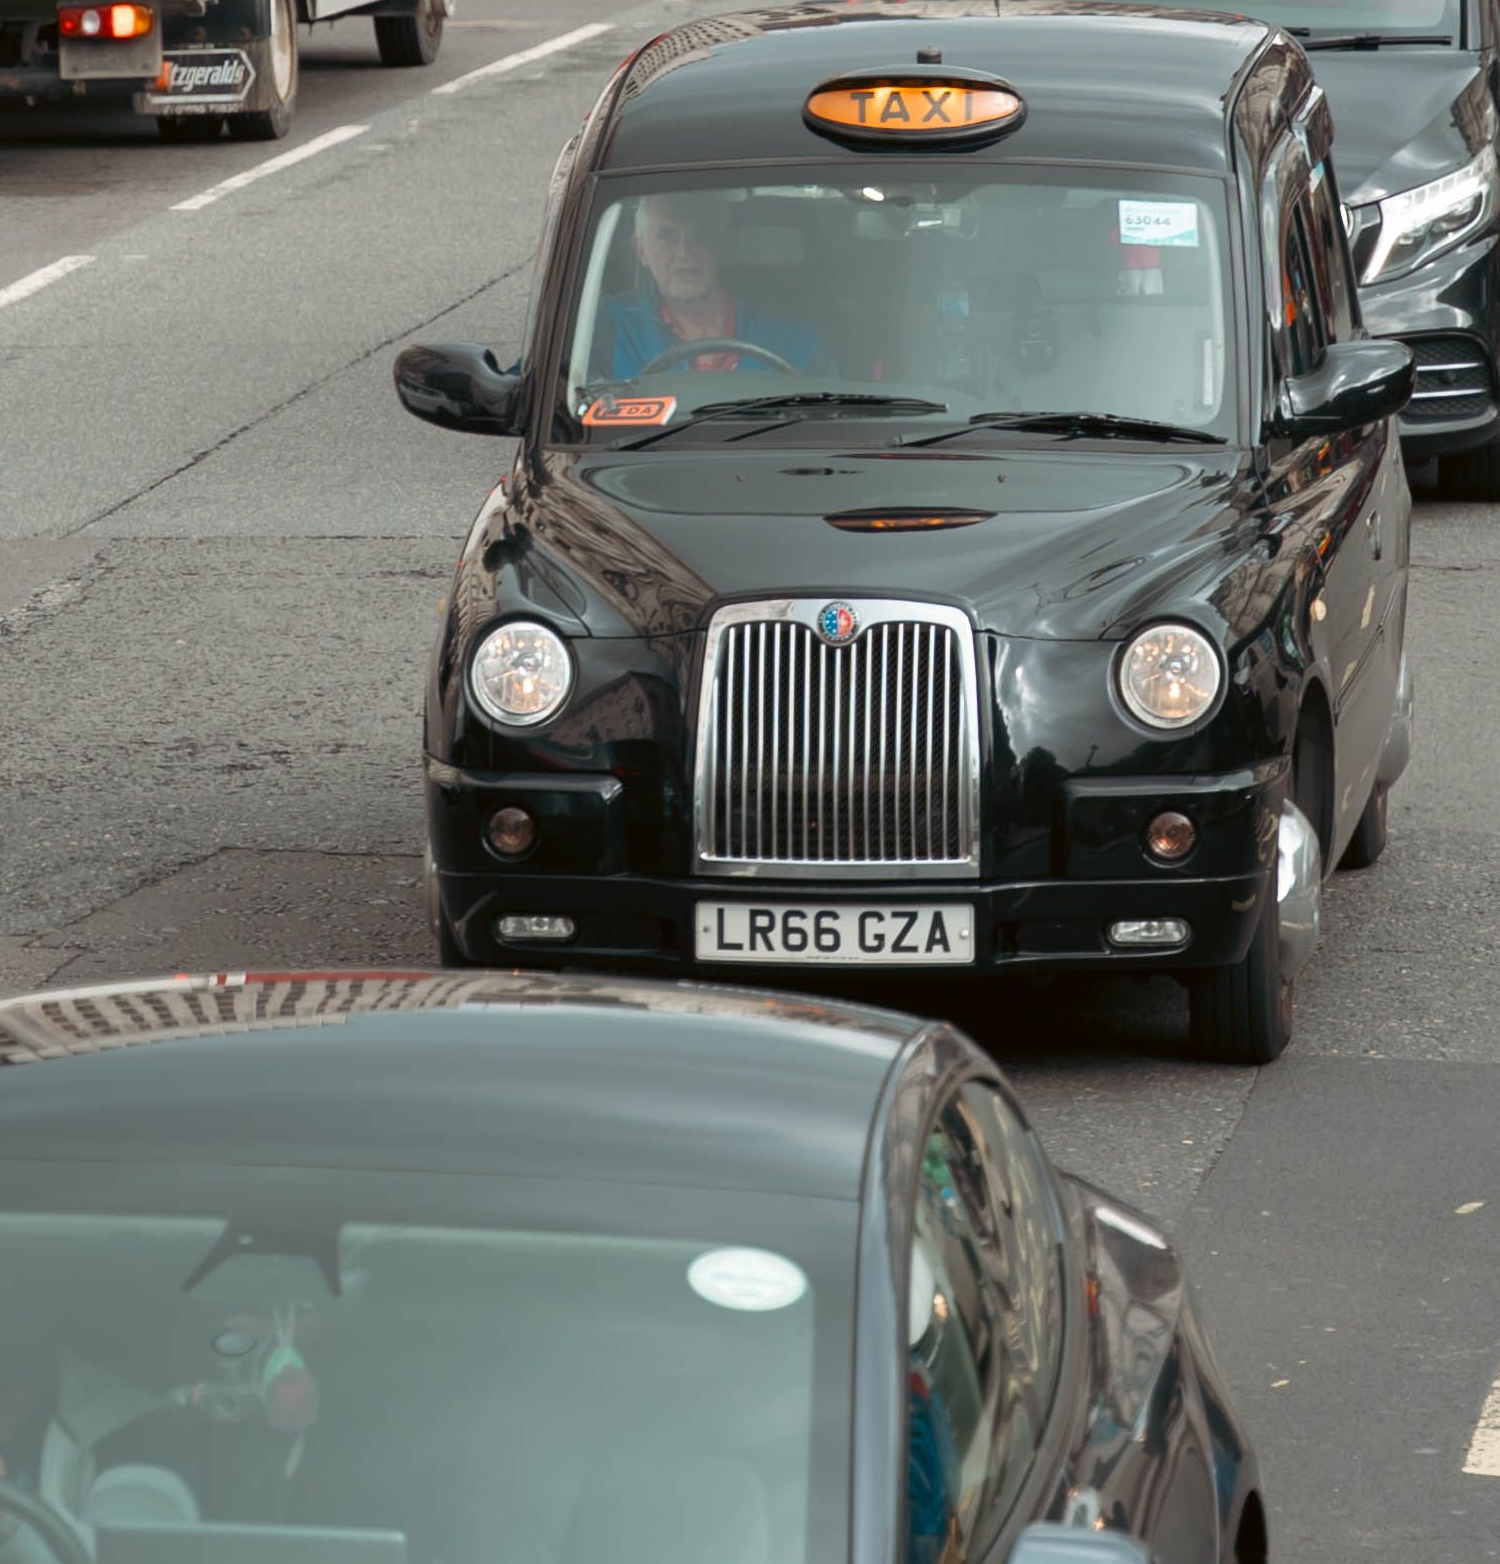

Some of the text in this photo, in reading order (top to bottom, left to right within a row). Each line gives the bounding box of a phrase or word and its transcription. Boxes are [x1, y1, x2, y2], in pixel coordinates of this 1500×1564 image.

[170, 60, 246, 92] tzgeralds
[851, 91, 973, 123] TAXI
[1124, 215, 1171, 226] 63044
[716, 908, 952, 954] LR66 GZA
